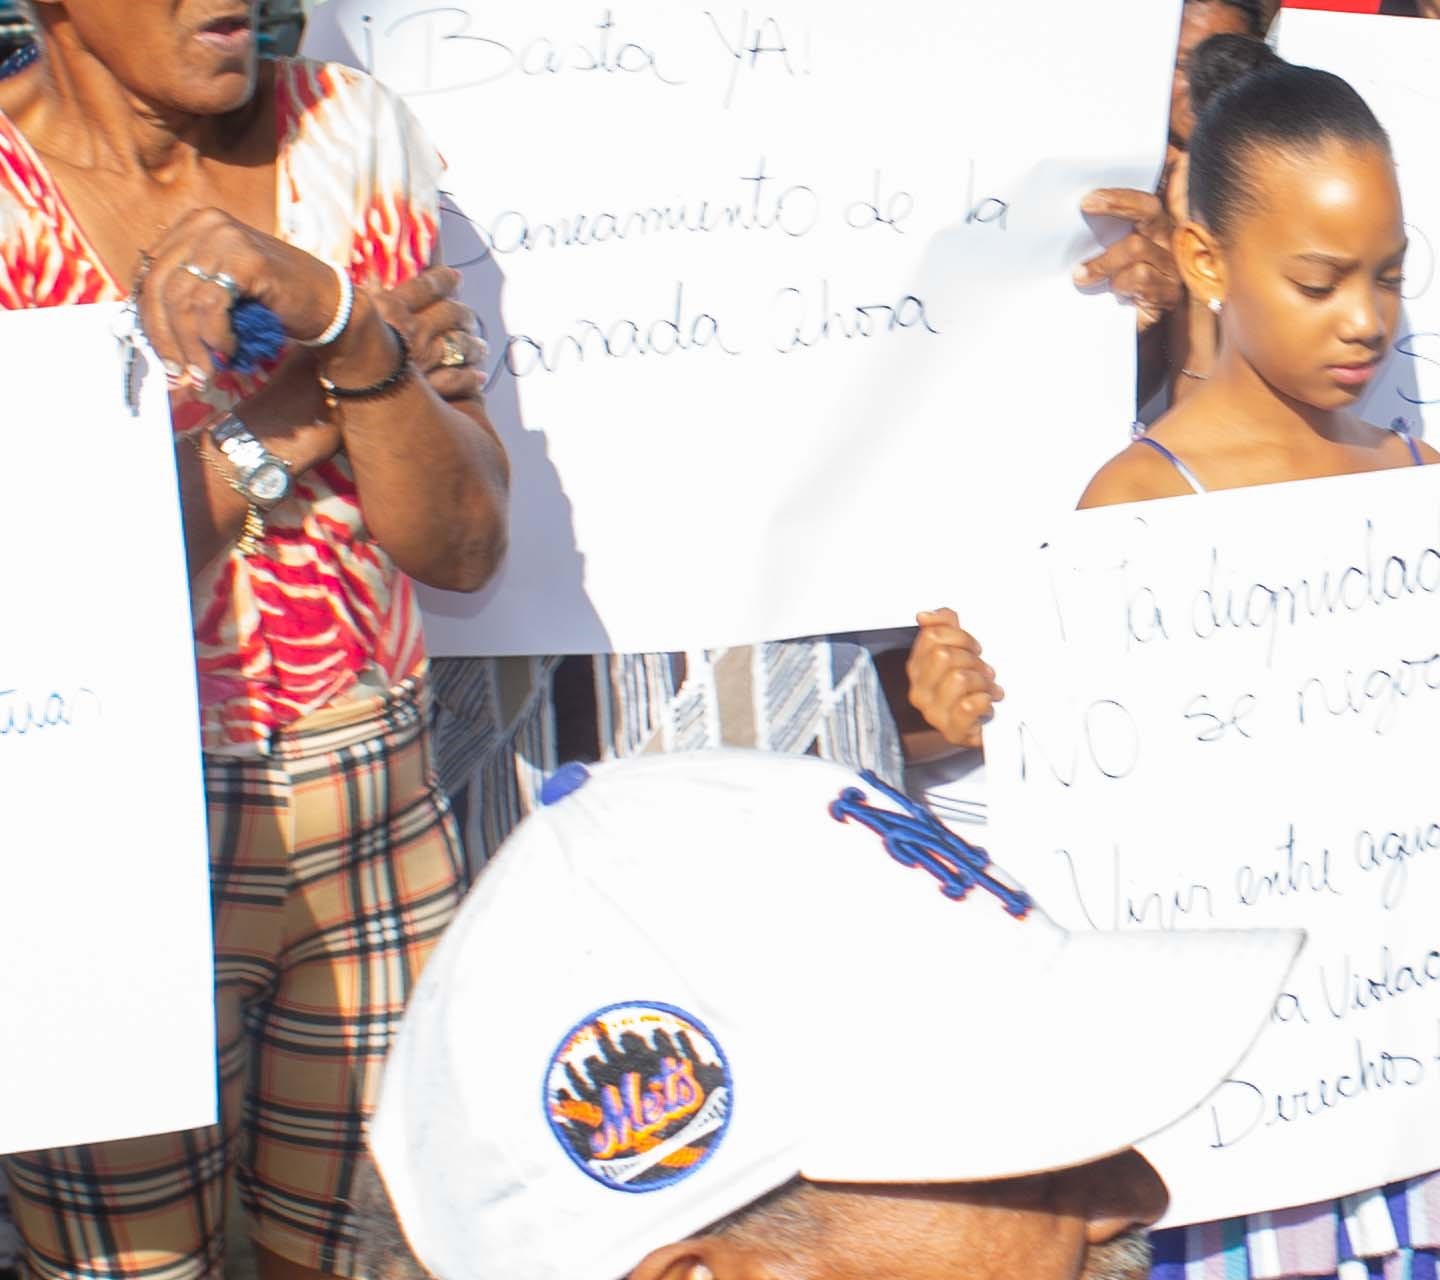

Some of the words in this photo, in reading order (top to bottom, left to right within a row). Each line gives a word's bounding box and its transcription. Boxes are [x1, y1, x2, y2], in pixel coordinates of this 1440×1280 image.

[845, 166, 916, 236] de
[965, 158, 1010, 233] la
[1183, 692, 1258, 744] se
[1234, 821, 1342, 908] entre
[589, 1055, 706, 1160] Mets
[1208, 1037, 1426, 1150] Derechos
